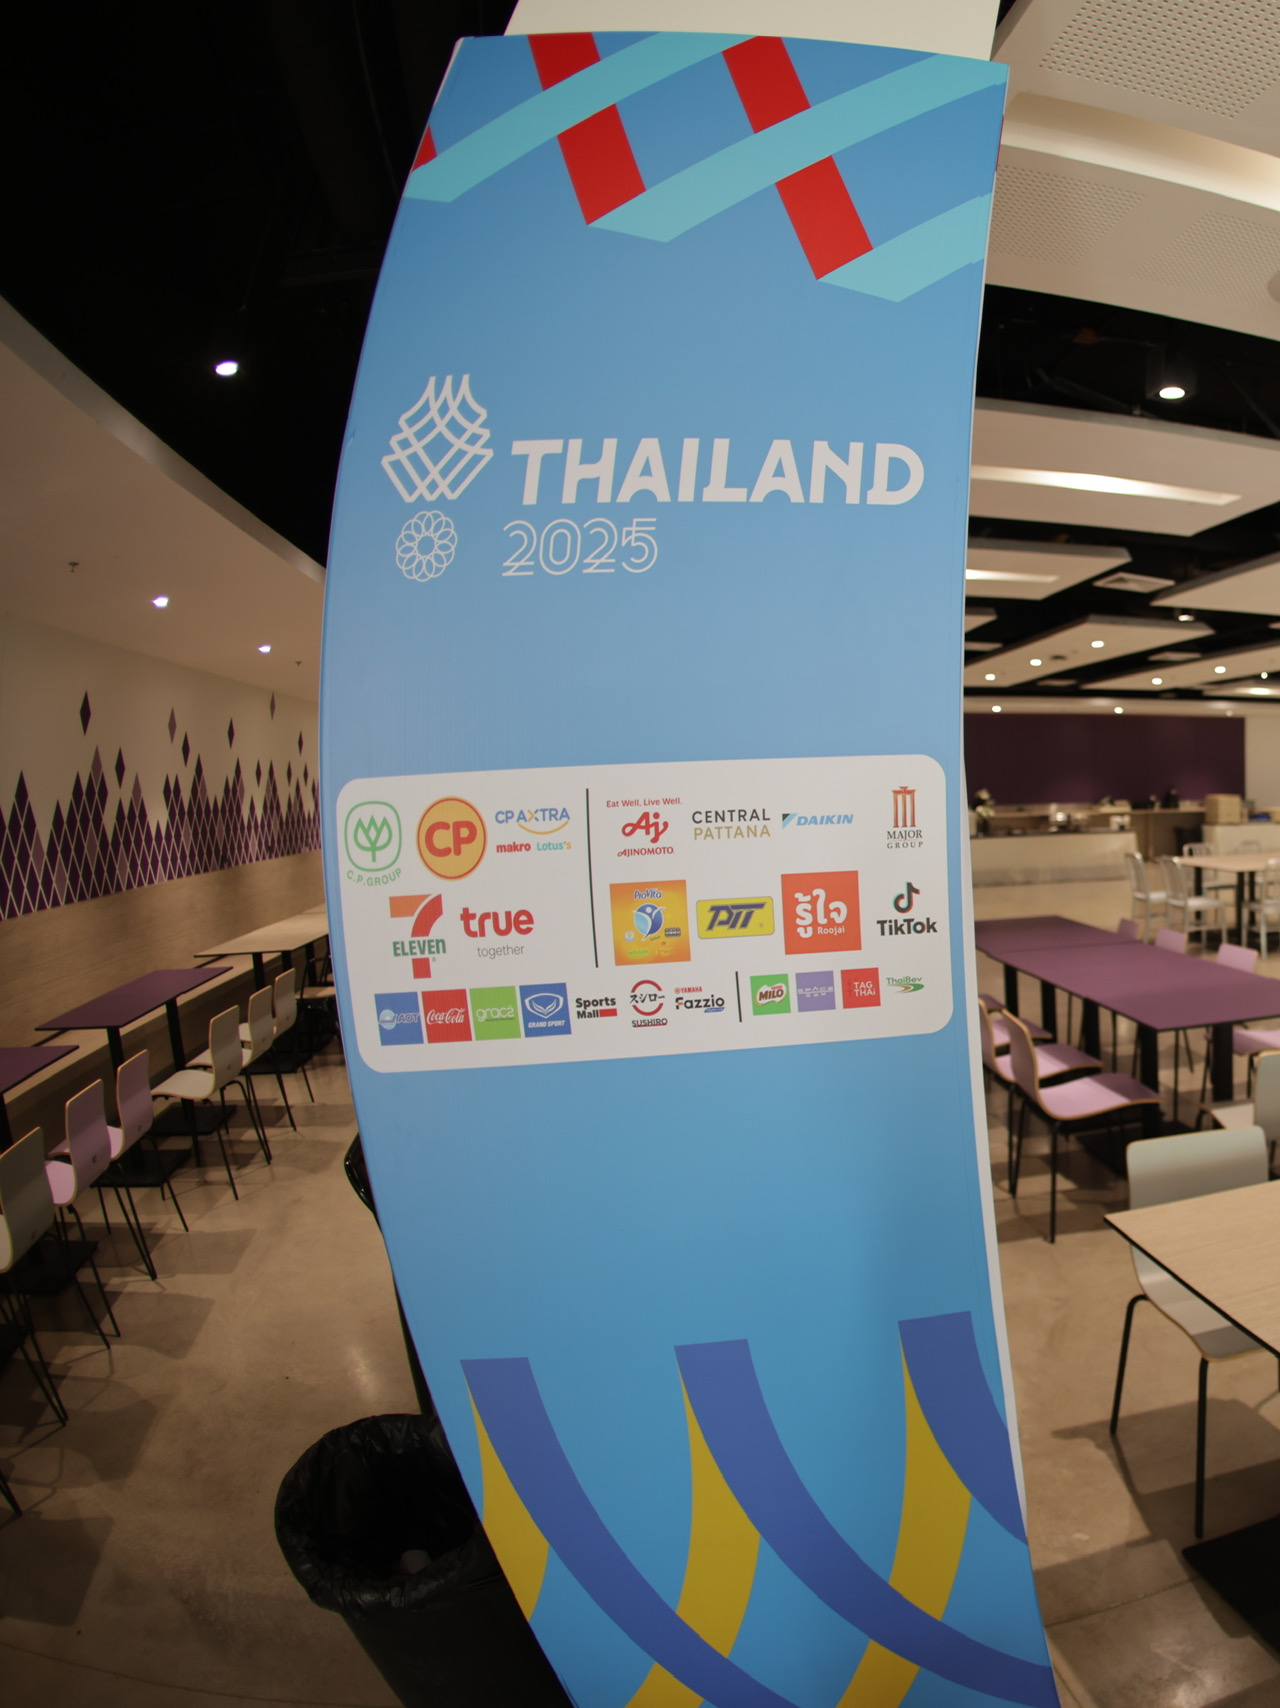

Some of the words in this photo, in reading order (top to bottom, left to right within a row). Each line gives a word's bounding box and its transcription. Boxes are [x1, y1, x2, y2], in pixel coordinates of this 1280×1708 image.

[511, 437, 925, 506] THAILAND
[502, 517, 658, 577] 2025
[606, 800, 619, 808] Eat
[643, 798, 660, 806] Live
[662, 797, 682, 805] Well.
[495, 810, 514, 824] CP
[516, 807, 570, 823] AXTRA
[692, 808, 771, 824] CENTRAL
[796, 814, 854, 826] DAIKIN
[424, 820, 478, 857] CP
[693, 825, 771, 841] PATTANA
[886, 829, 923, 841] MAJOR
[496, 841, 531, 853] makro
[537, 841, 572, 851] Lotus's
[617, 846, 674, 857] AJINOMOTO
[887, 841, 923, 849] GROUP
[705, 902, 767, 932] PTT
[794, 888, 848, 939] รู้ใจ
[460, 907, 534, 938] true
[876, 918, 938, 936] TikTok
[389, 893, 443, 978] 7
[817, 926, 846, 936] Roojai
[477, 944, 525, 959] together
[853, 981, 873, 989] TAG
[885, 976, 923, 985] ThaiBev
[630, 993, 666, 1004] スシロー
[759, 989, 784, 1001] MILO
[575, 996, 616, 1010] Sports
[675, 995, 725, 1010] Fazzio
[577, 1009, 599, 1019] Mall
[547, 1020, 565, 1028] SPORT
[632, 1018, 668, 1027] SUSHIRO
